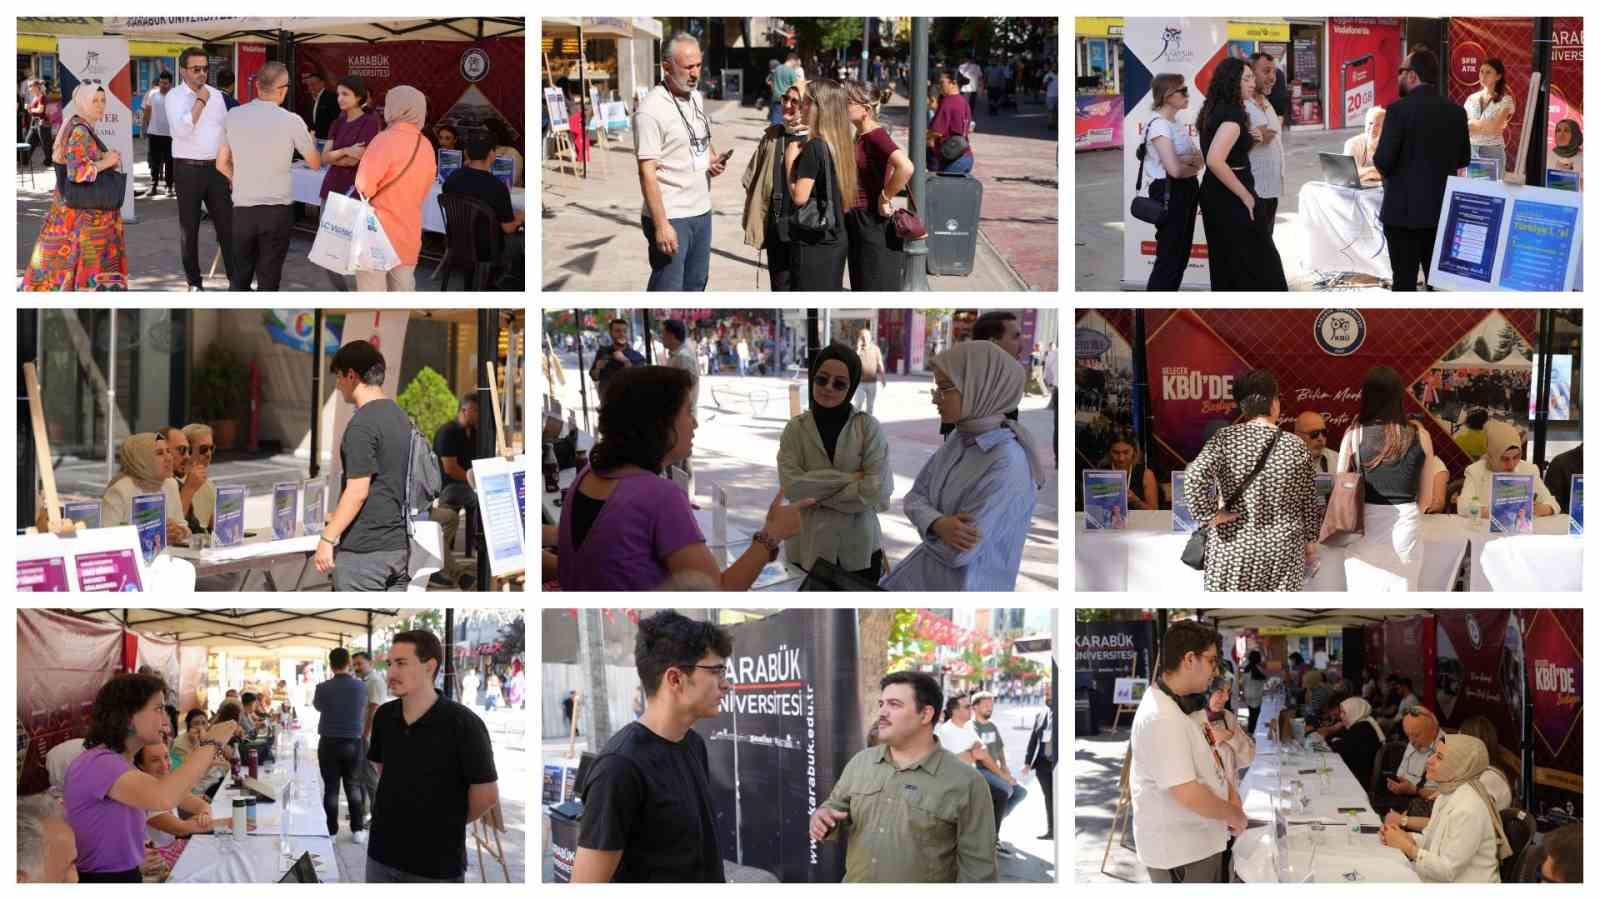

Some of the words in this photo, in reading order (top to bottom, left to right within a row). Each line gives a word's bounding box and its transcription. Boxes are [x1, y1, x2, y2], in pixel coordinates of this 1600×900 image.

[1551, 31, 1585, 45] ARA
[348, 54, 390, 66] KARABÜK
[1347, 93, 1361, 112] 20
[1162, 370, 1235, 401] KBÜ'DE
[724, 643, 801, 684] ARABÜK
[718, 688, 804, 716] NİVERSİTESİ
